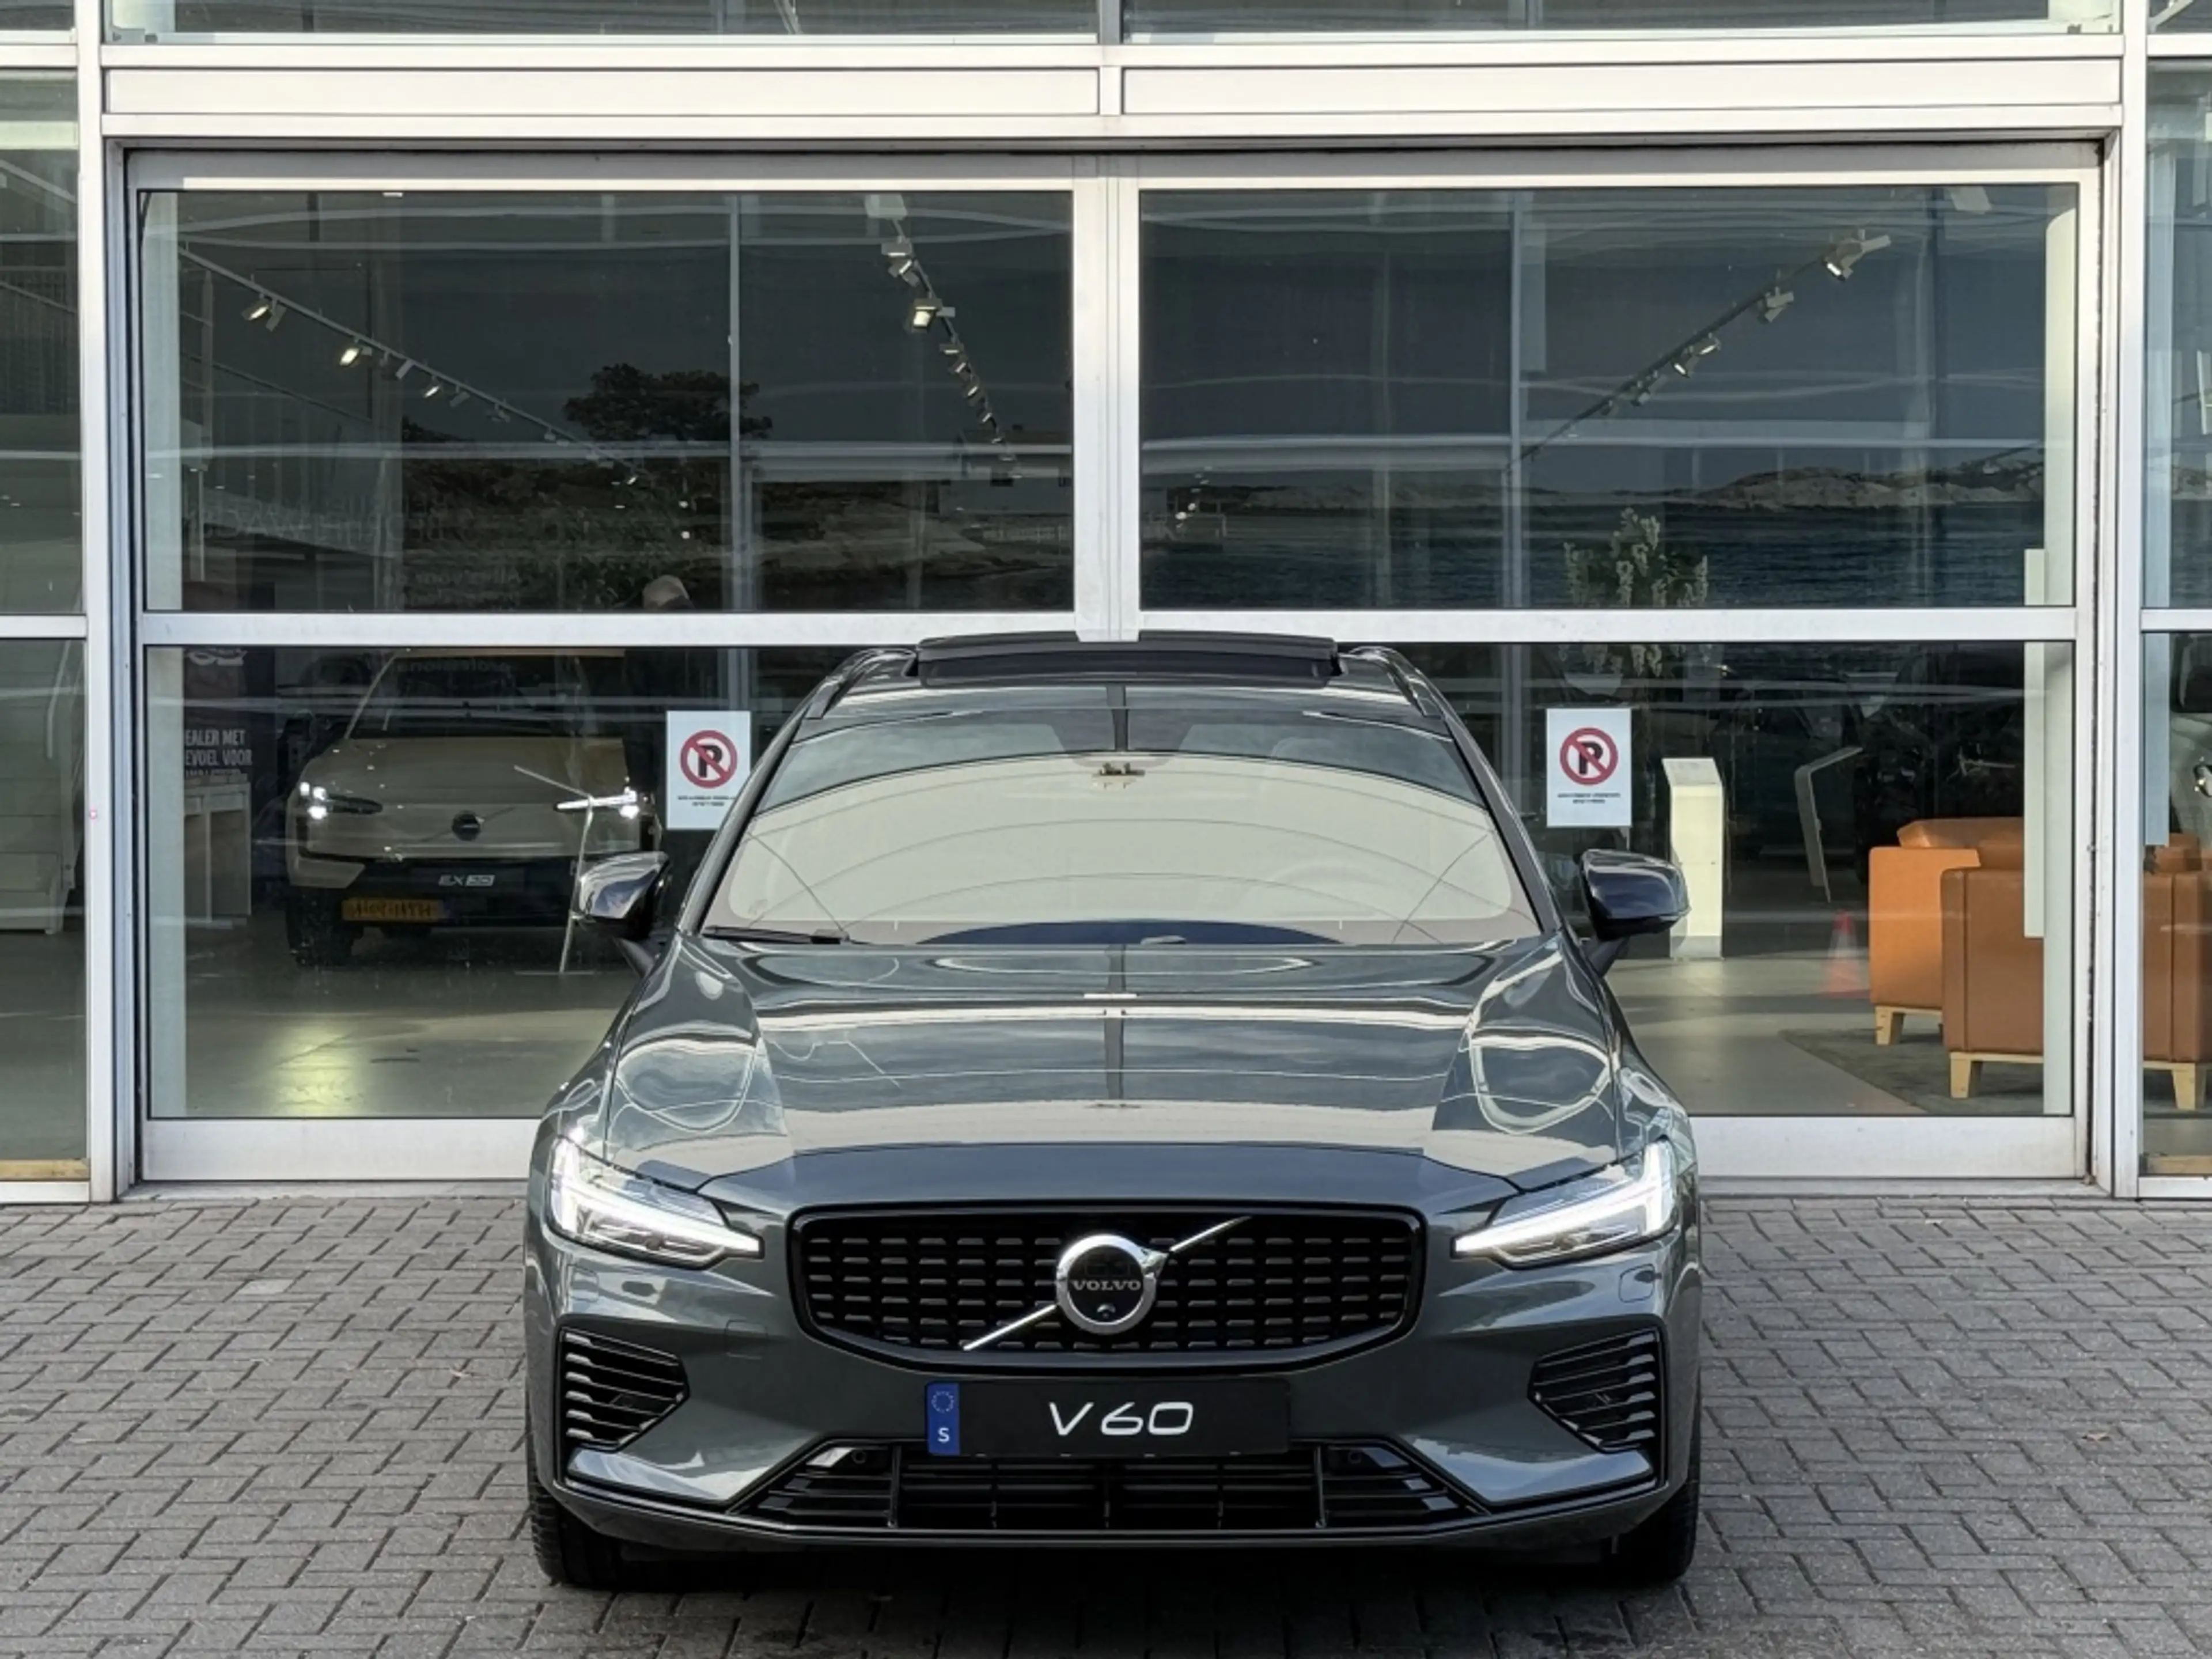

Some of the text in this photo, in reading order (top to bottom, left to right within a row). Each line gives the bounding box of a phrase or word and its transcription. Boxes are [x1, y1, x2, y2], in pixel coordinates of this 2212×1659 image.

[184, 729, 246, 746] EALER MET
[184, 749, 219, 766] EVOEL
[1071, 1280, 1142, 1291] VOLVO
[937, 1427, 950, 1444] S
